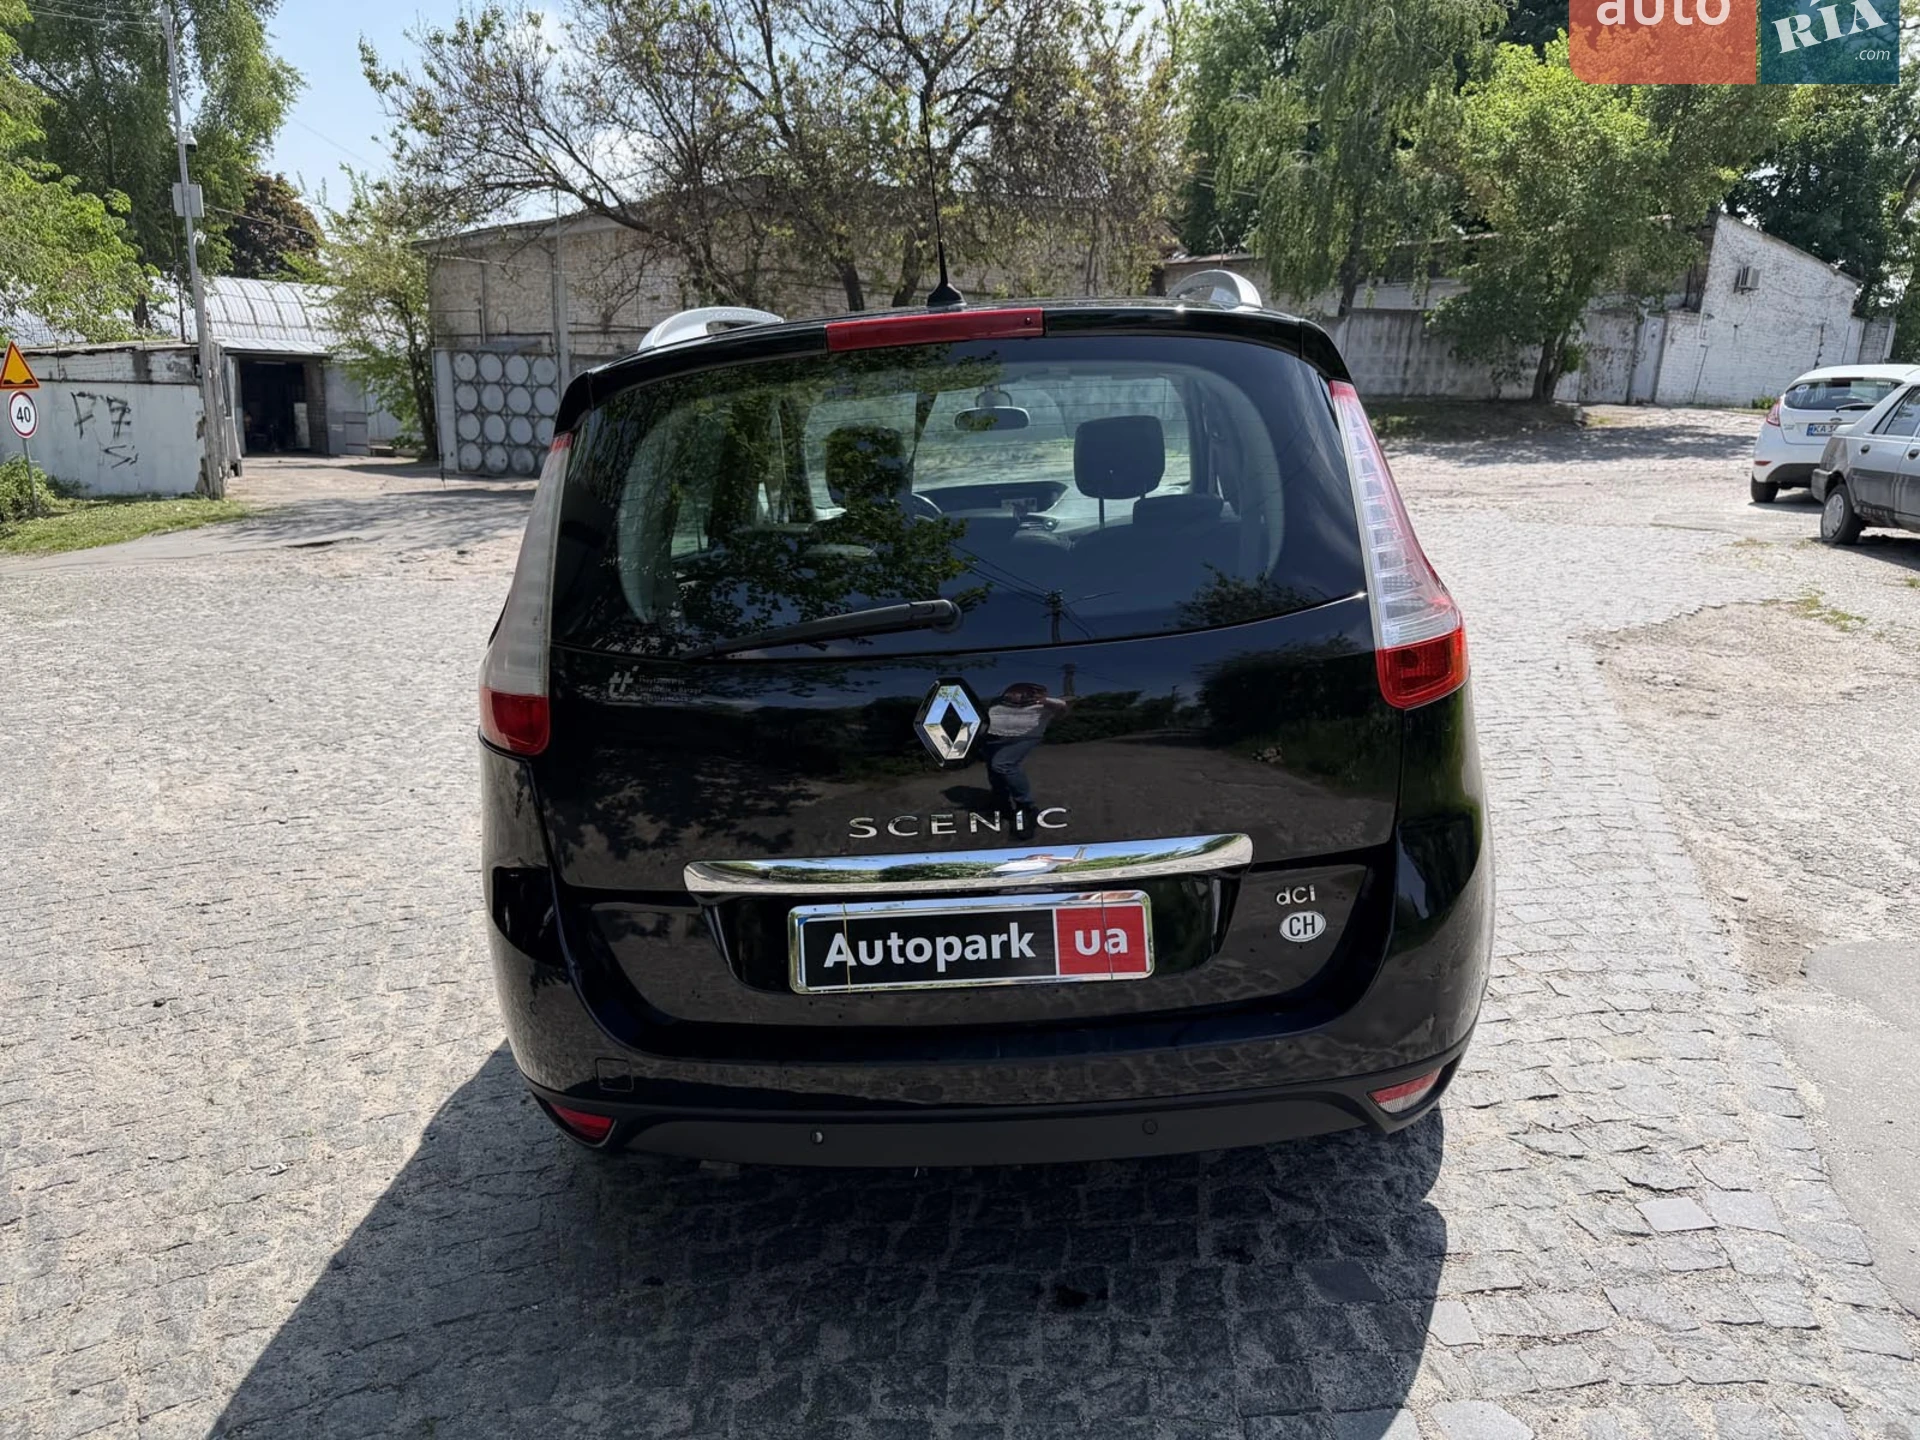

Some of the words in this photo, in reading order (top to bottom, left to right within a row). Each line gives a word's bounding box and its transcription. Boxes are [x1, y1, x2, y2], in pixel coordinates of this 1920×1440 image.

[16, 406, 31, 423] 40
[849, 807, 1068, 839] SCENIC
[1289, 915, 1316, 937] CH
[823, 922, 1036, 973] Autopark
[1074, 927, 1129, 956] ua
